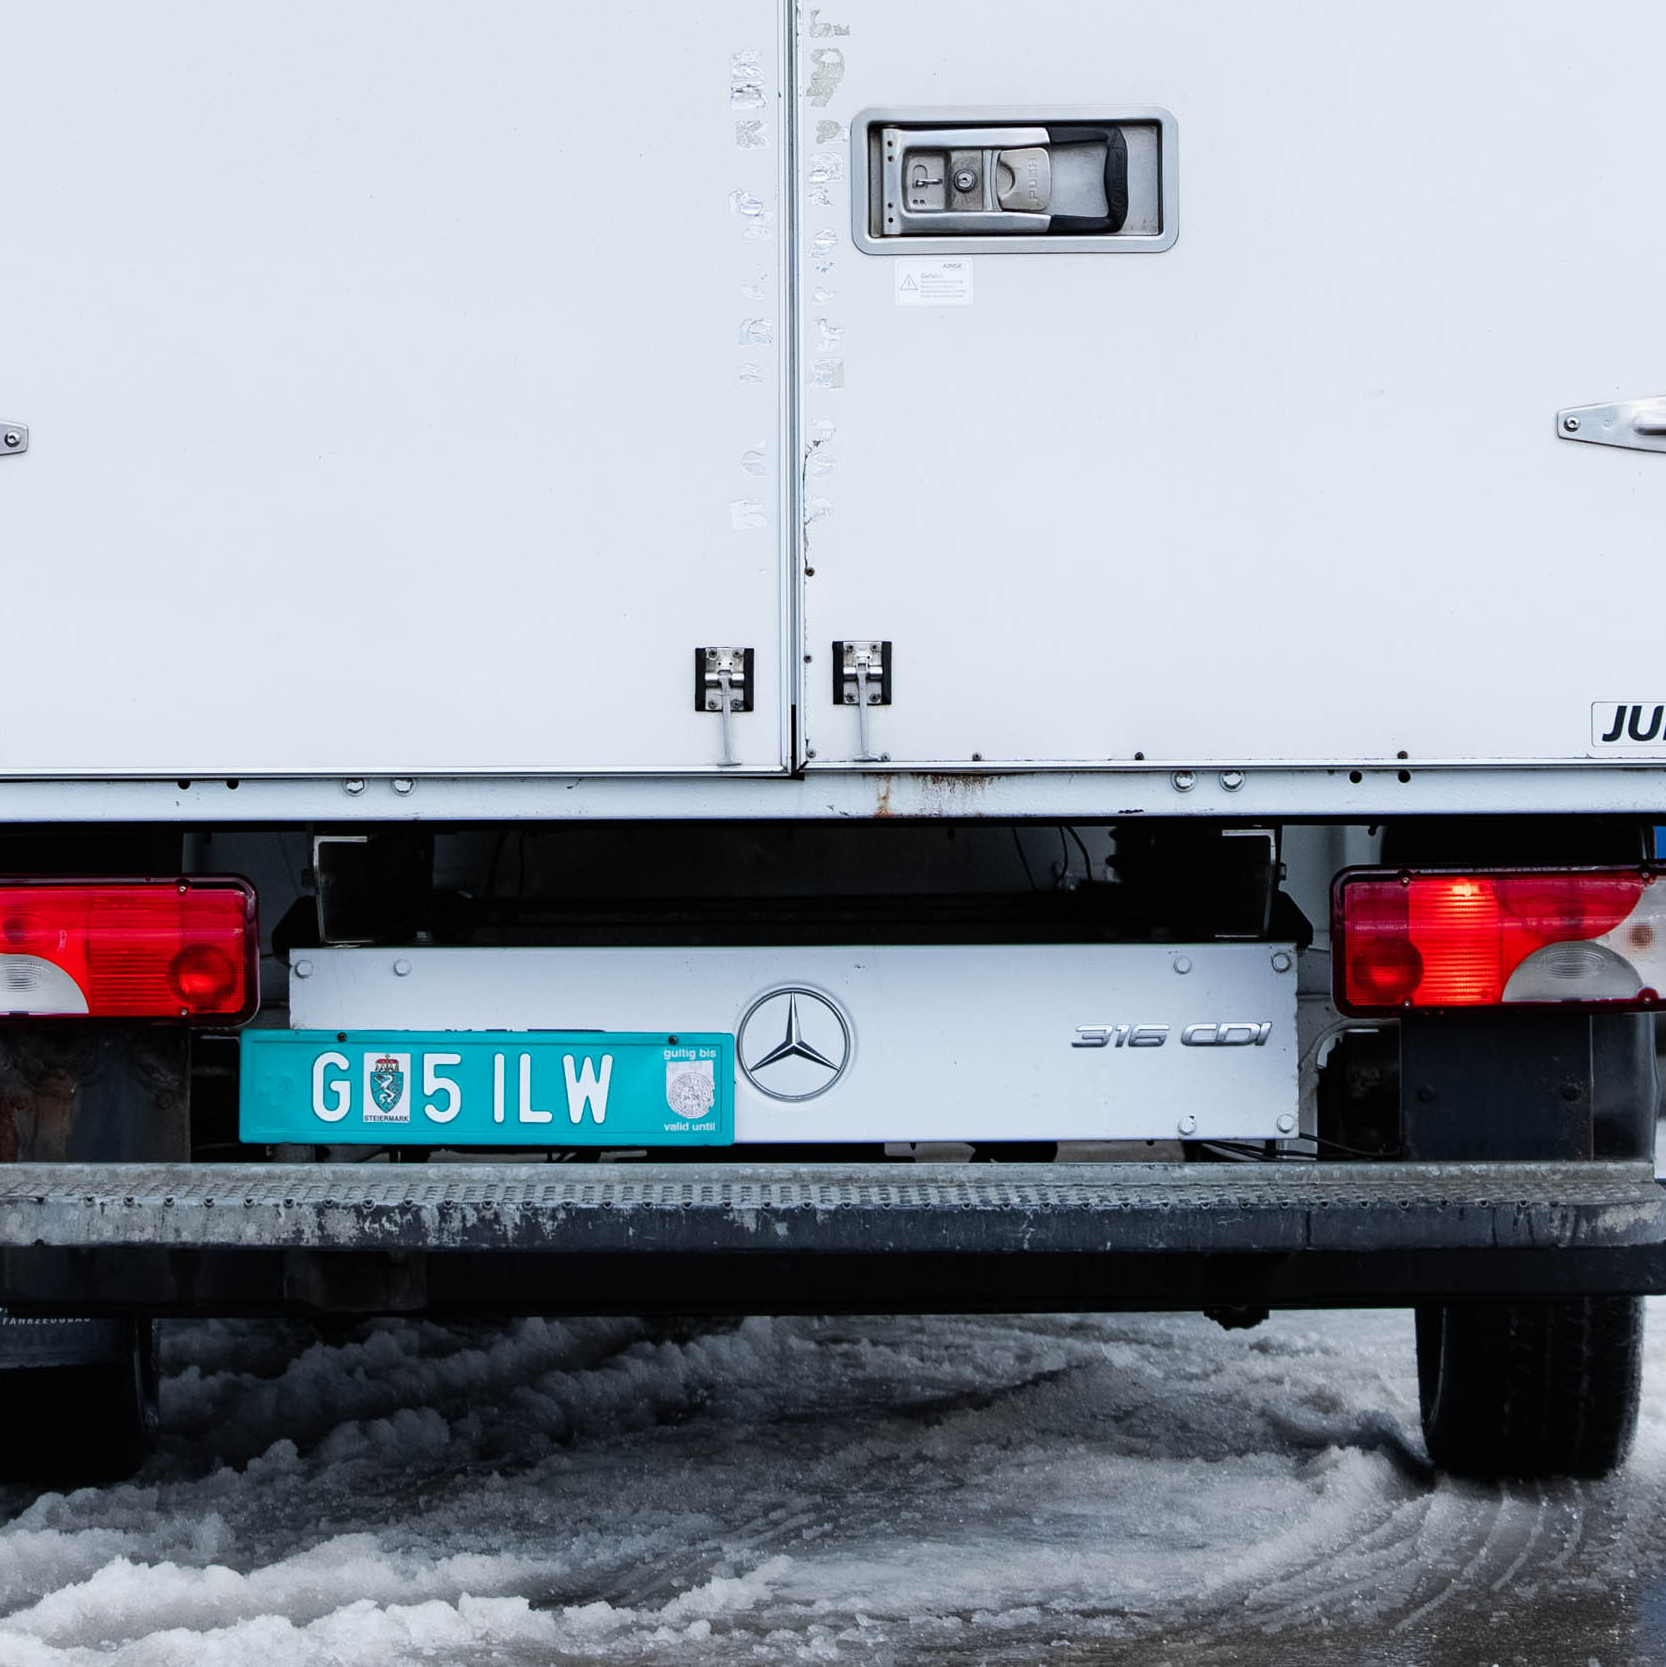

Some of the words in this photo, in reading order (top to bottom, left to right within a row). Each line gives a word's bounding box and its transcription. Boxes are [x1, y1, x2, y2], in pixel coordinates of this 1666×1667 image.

[1071, 1023, 1171, 1048] 316
[1180, 1021, 1273, 1047] CDI
[699, 1048, 717, 1058] bis
[311, 1052, 351, 1122] G
[423, 1053, 462, 1123] 5
[663, 1122, 690, 1131] valid
[692, 1122, 716, 1131] until
